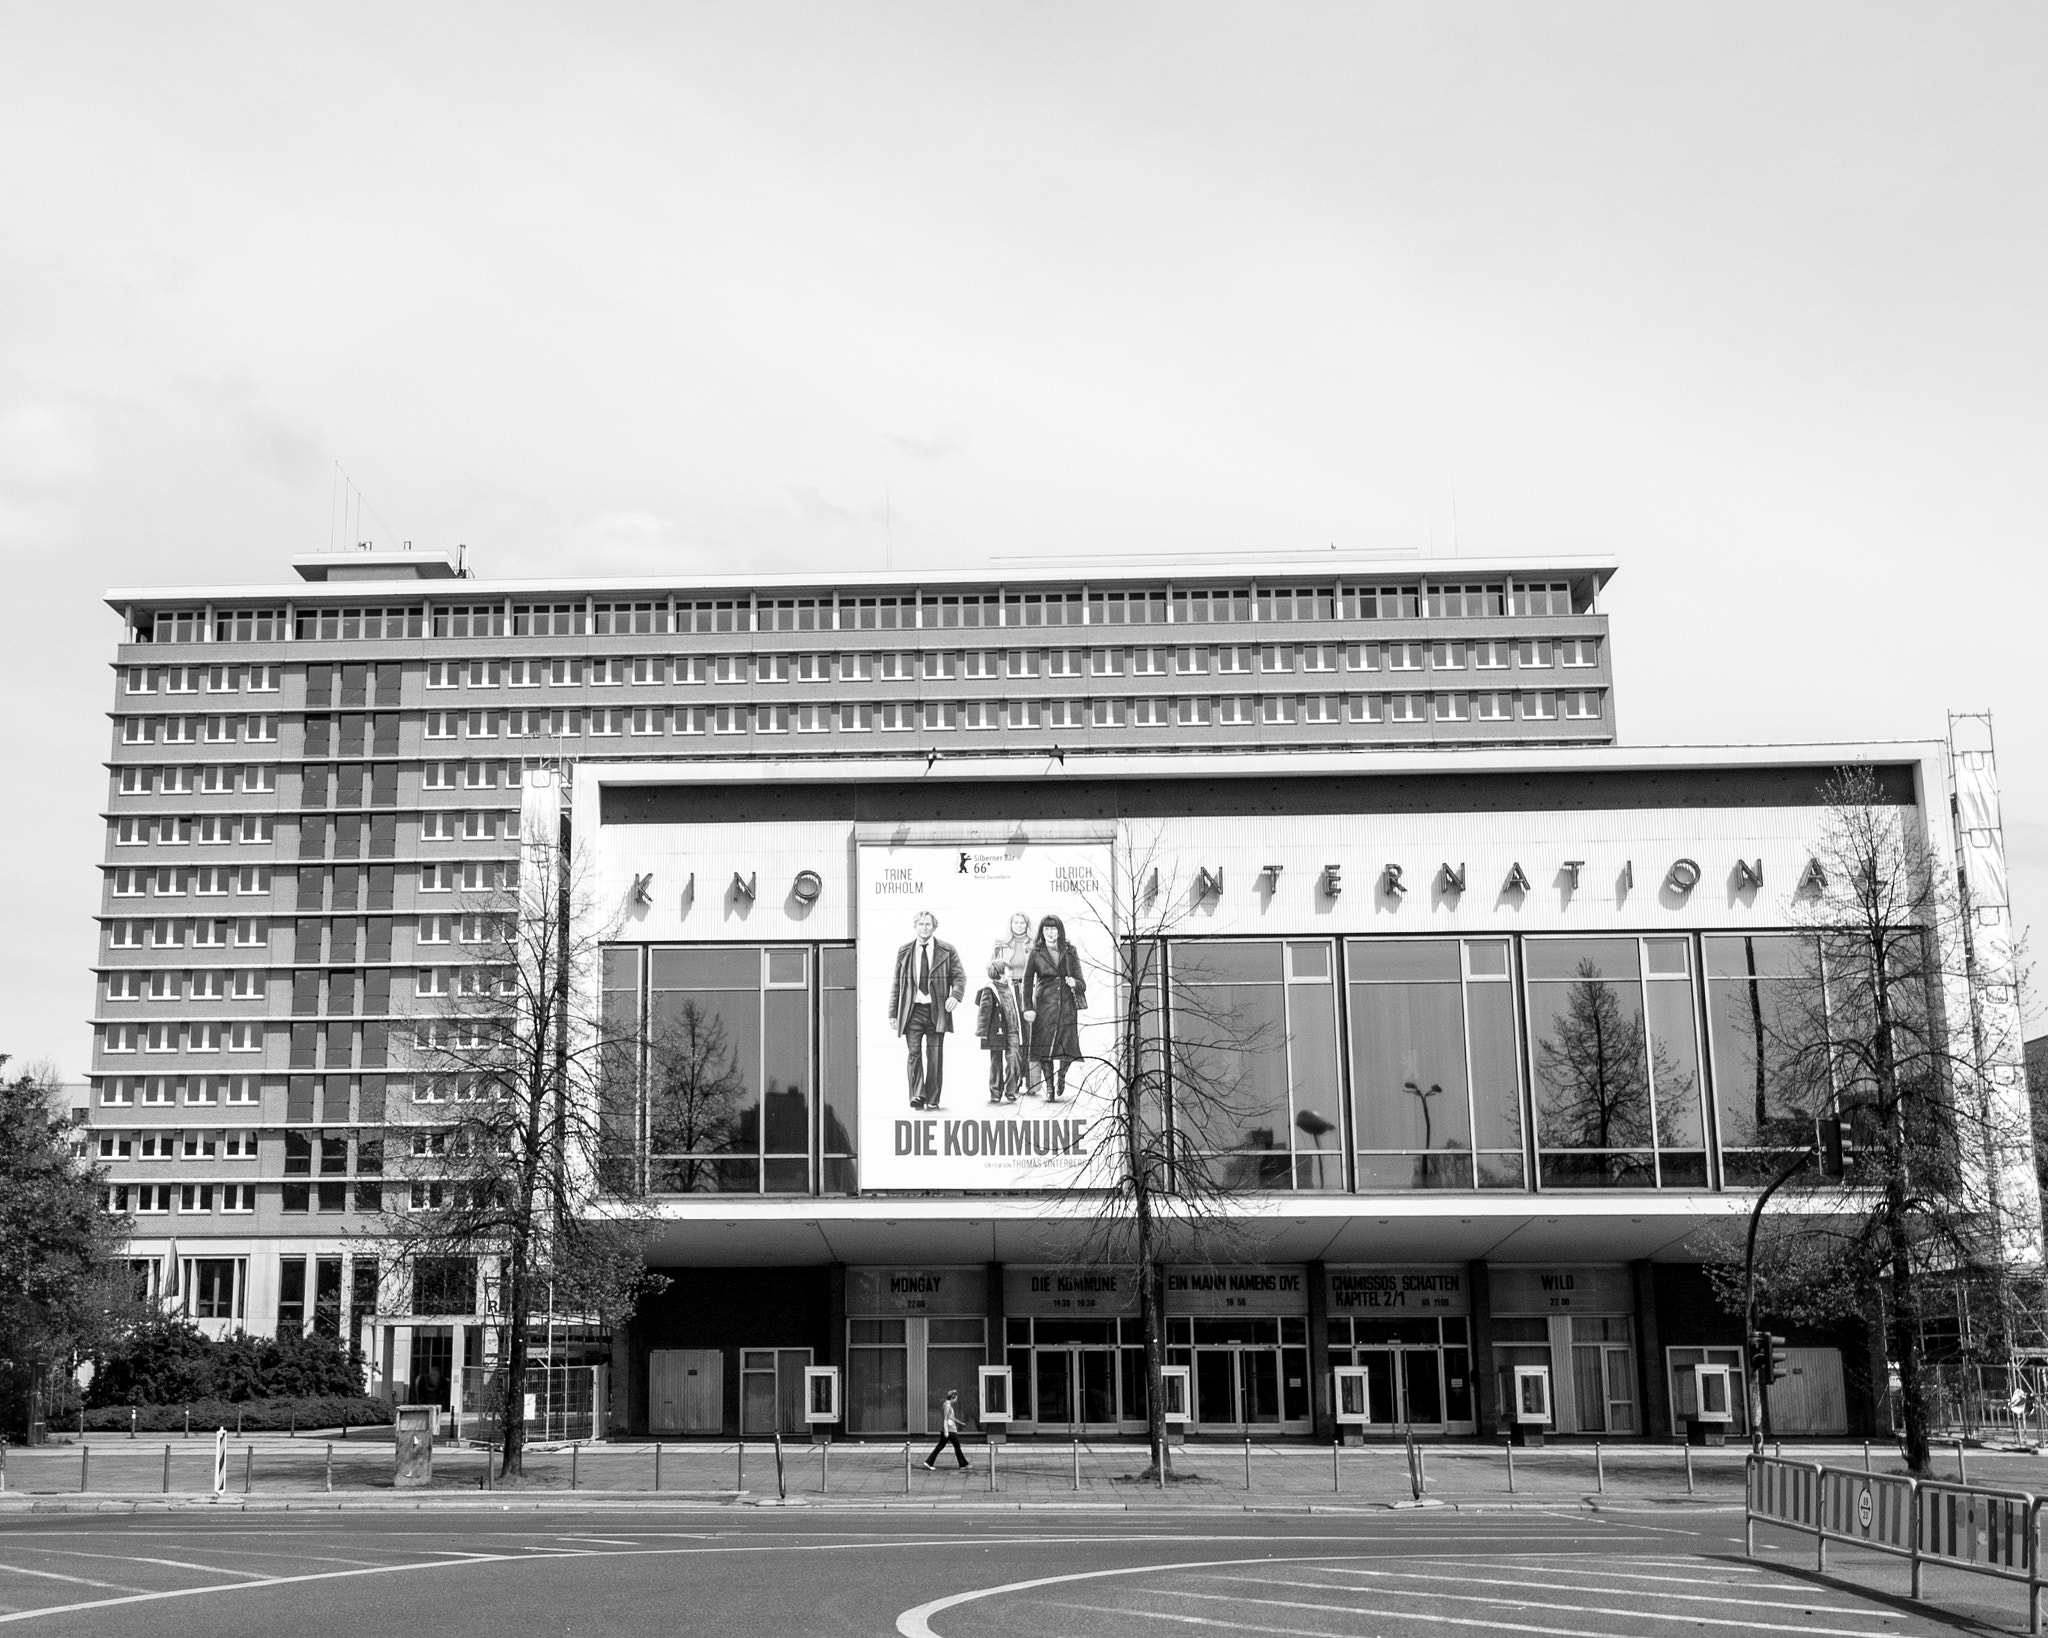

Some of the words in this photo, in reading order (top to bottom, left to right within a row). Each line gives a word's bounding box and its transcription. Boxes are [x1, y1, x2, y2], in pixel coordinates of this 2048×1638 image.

[974, 854, 1002, 862] Silberner
[884, 868, 913, 881] TRINE
[1055, 866, 1092, 879] ULRICH
[635, 869, 822, 902] KINO
[875, 882, 924, 894] DYRHOLM
[1049, 879, 1099, 893] THOMSEN
[894, 1120, 938, 1156] DIE
[944, 1119, 1088, 1157] KOMMUNE
[1012, 1158, 1041, 1168] THOMAS
[890, 1277, 941, 1293] MONGAY
[1031, 1276, 1050, 1292] DIE
[1057, 1276, 1118, 1292] KOMMUNE
[1168, 1275, 1188, 1291] EIN
[1191, 1275, 1226, 1291] MANN
[1230, 1275, 1276, 1291] NAMENS
[1279, 1275, 1300, 1291] OVE
[1332, 1275, 1397, 1291] CHAMISSOS
[1402, 1275, 1459, 1291] SCHATTEN
[1540, 1274, 1574, 1291] WILD
[1335, 1291, 1380, 1307] KAPITEL
[1384, 1290, 1406, 1307] 2/1
